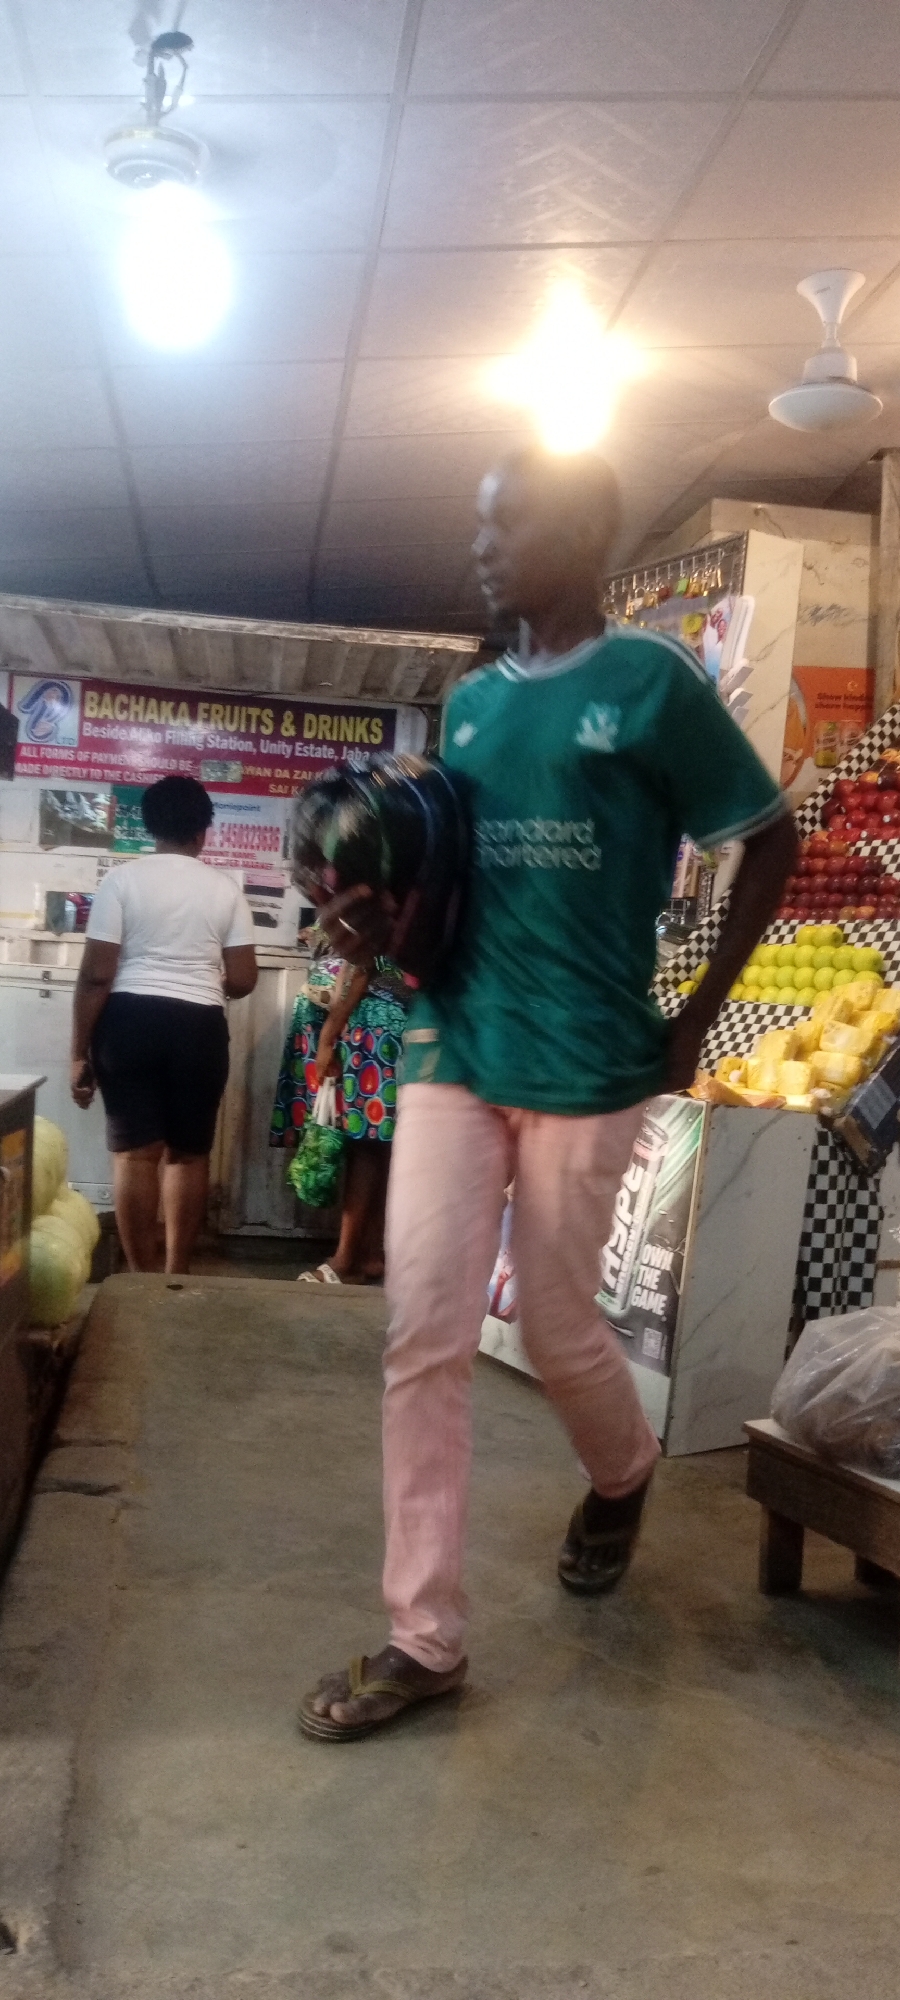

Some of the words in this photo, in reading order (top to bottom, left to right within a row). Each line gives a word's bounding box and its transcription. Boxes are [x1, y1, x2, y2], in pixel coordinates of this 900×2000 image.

[84, 690, 191, 726] BACHAKA
[197, 702, 275, 736] FRUITS
[280, 710, 297, 737] &
[303, 713, 384, 745] DRINKS
[20, 746, 39, 758] ALL
[40, 747, 76, 761] FORMS
[76, 750, 92, 762] OF
[83, 721, 128, 740] Beside
[260, 739, 294, 759] Unity
[294, 742, 338, 762] Estate,
[642, 1242, 675, 1271] OWN
[636, 1264, 662, 1291] THE
